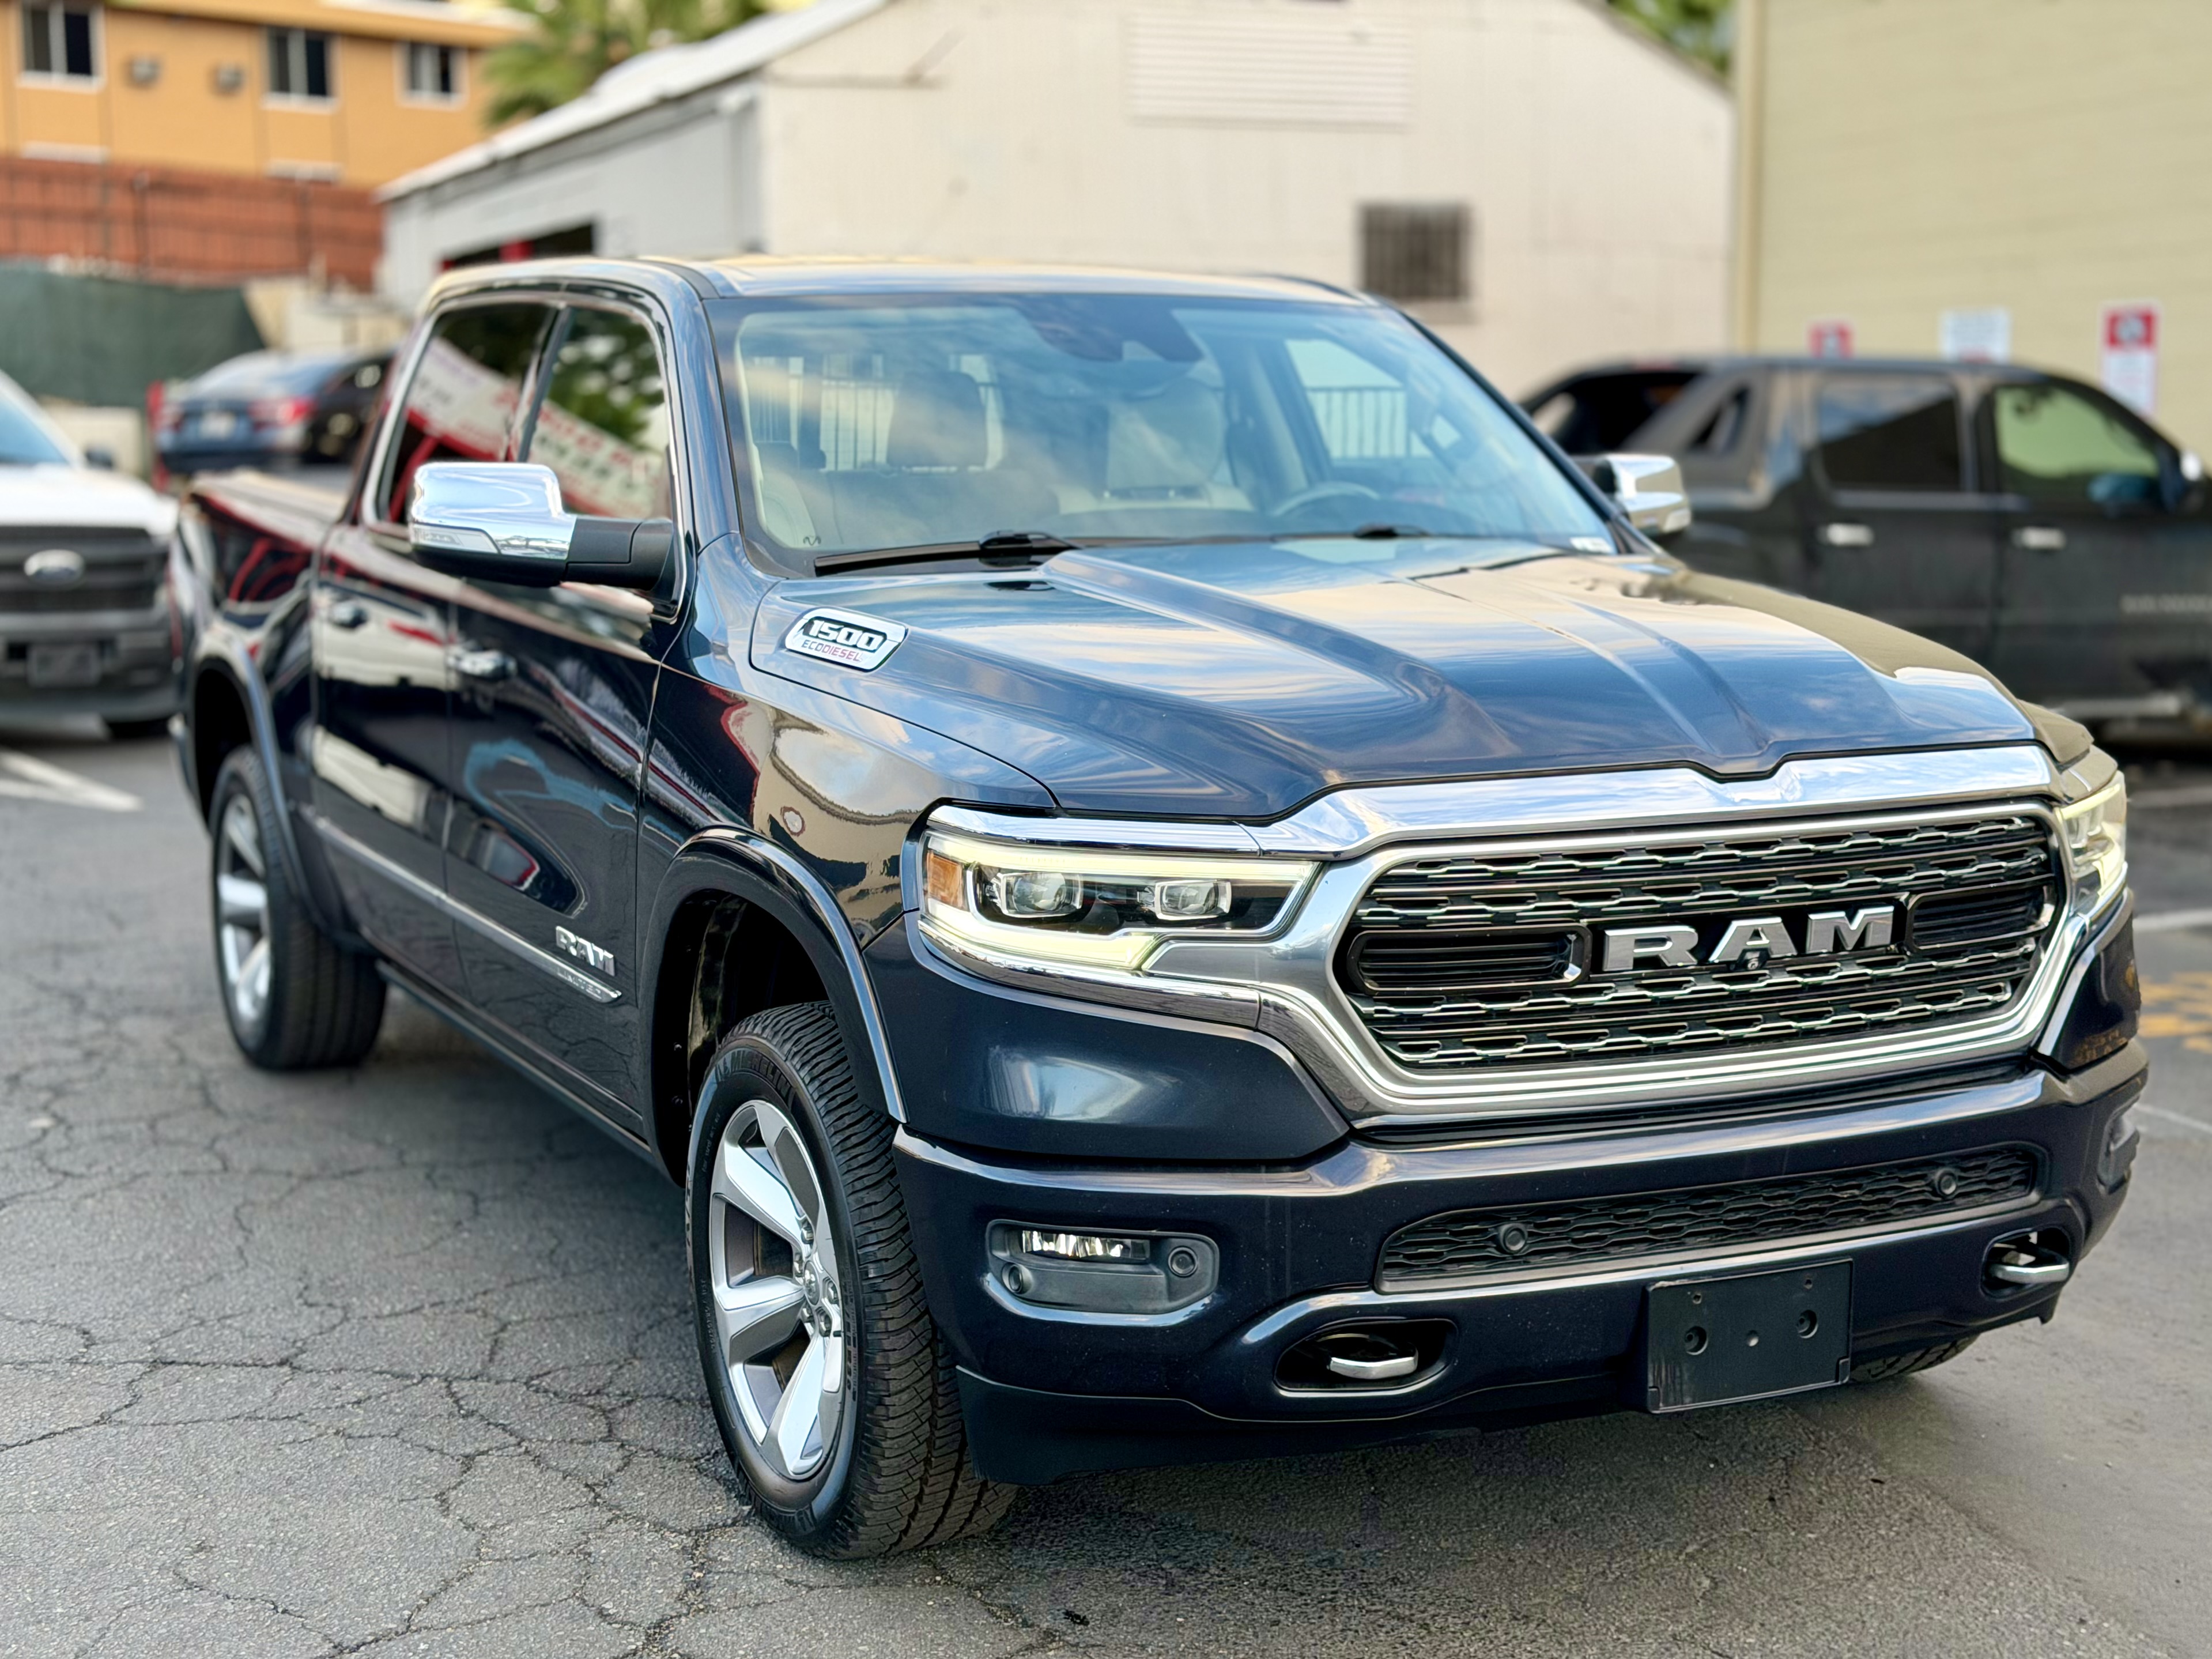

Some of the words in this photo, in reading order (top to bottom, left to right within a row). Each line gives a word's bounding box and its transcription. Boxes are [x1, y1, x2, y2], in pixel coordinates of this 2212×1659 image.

[801, 639, 861, 662] ECODIESEL
[808, 620, 884, 651] 1500
[556, 925, 616, 977] RAM
[1602, 906, 1894, 971] RAM
